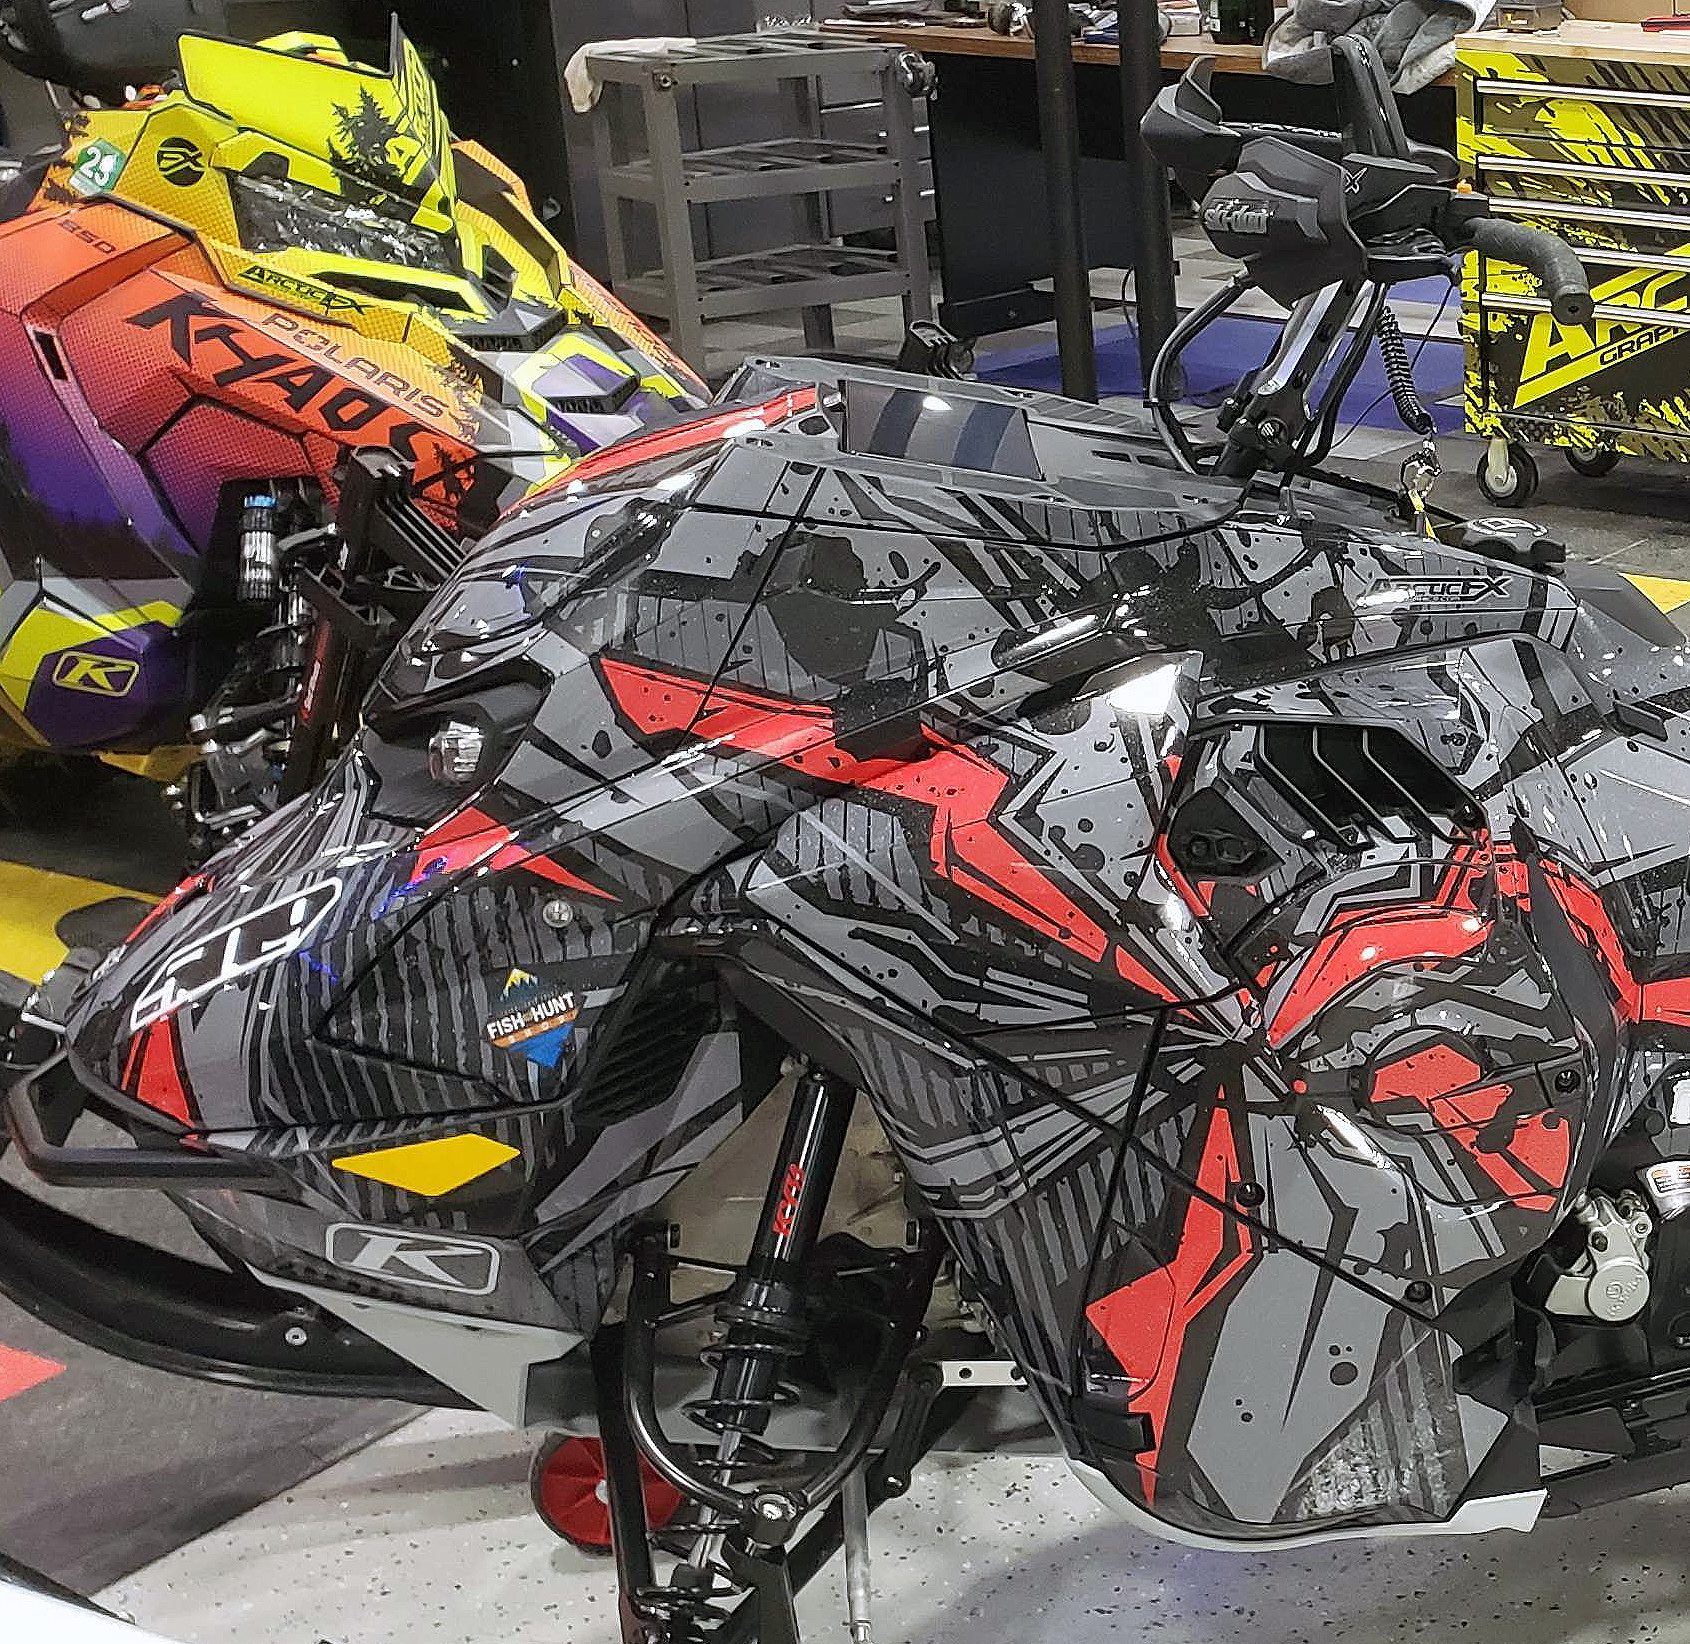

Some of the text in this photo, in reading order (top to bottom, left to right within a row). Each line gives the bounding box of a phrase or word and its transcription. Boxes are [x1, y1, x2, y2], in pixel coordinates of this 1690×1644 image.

[261, 312, 449, 418] POLARIS
[487, 1011, 526, 1040] FISH
[530, 991, 575, 1022] HUNT
